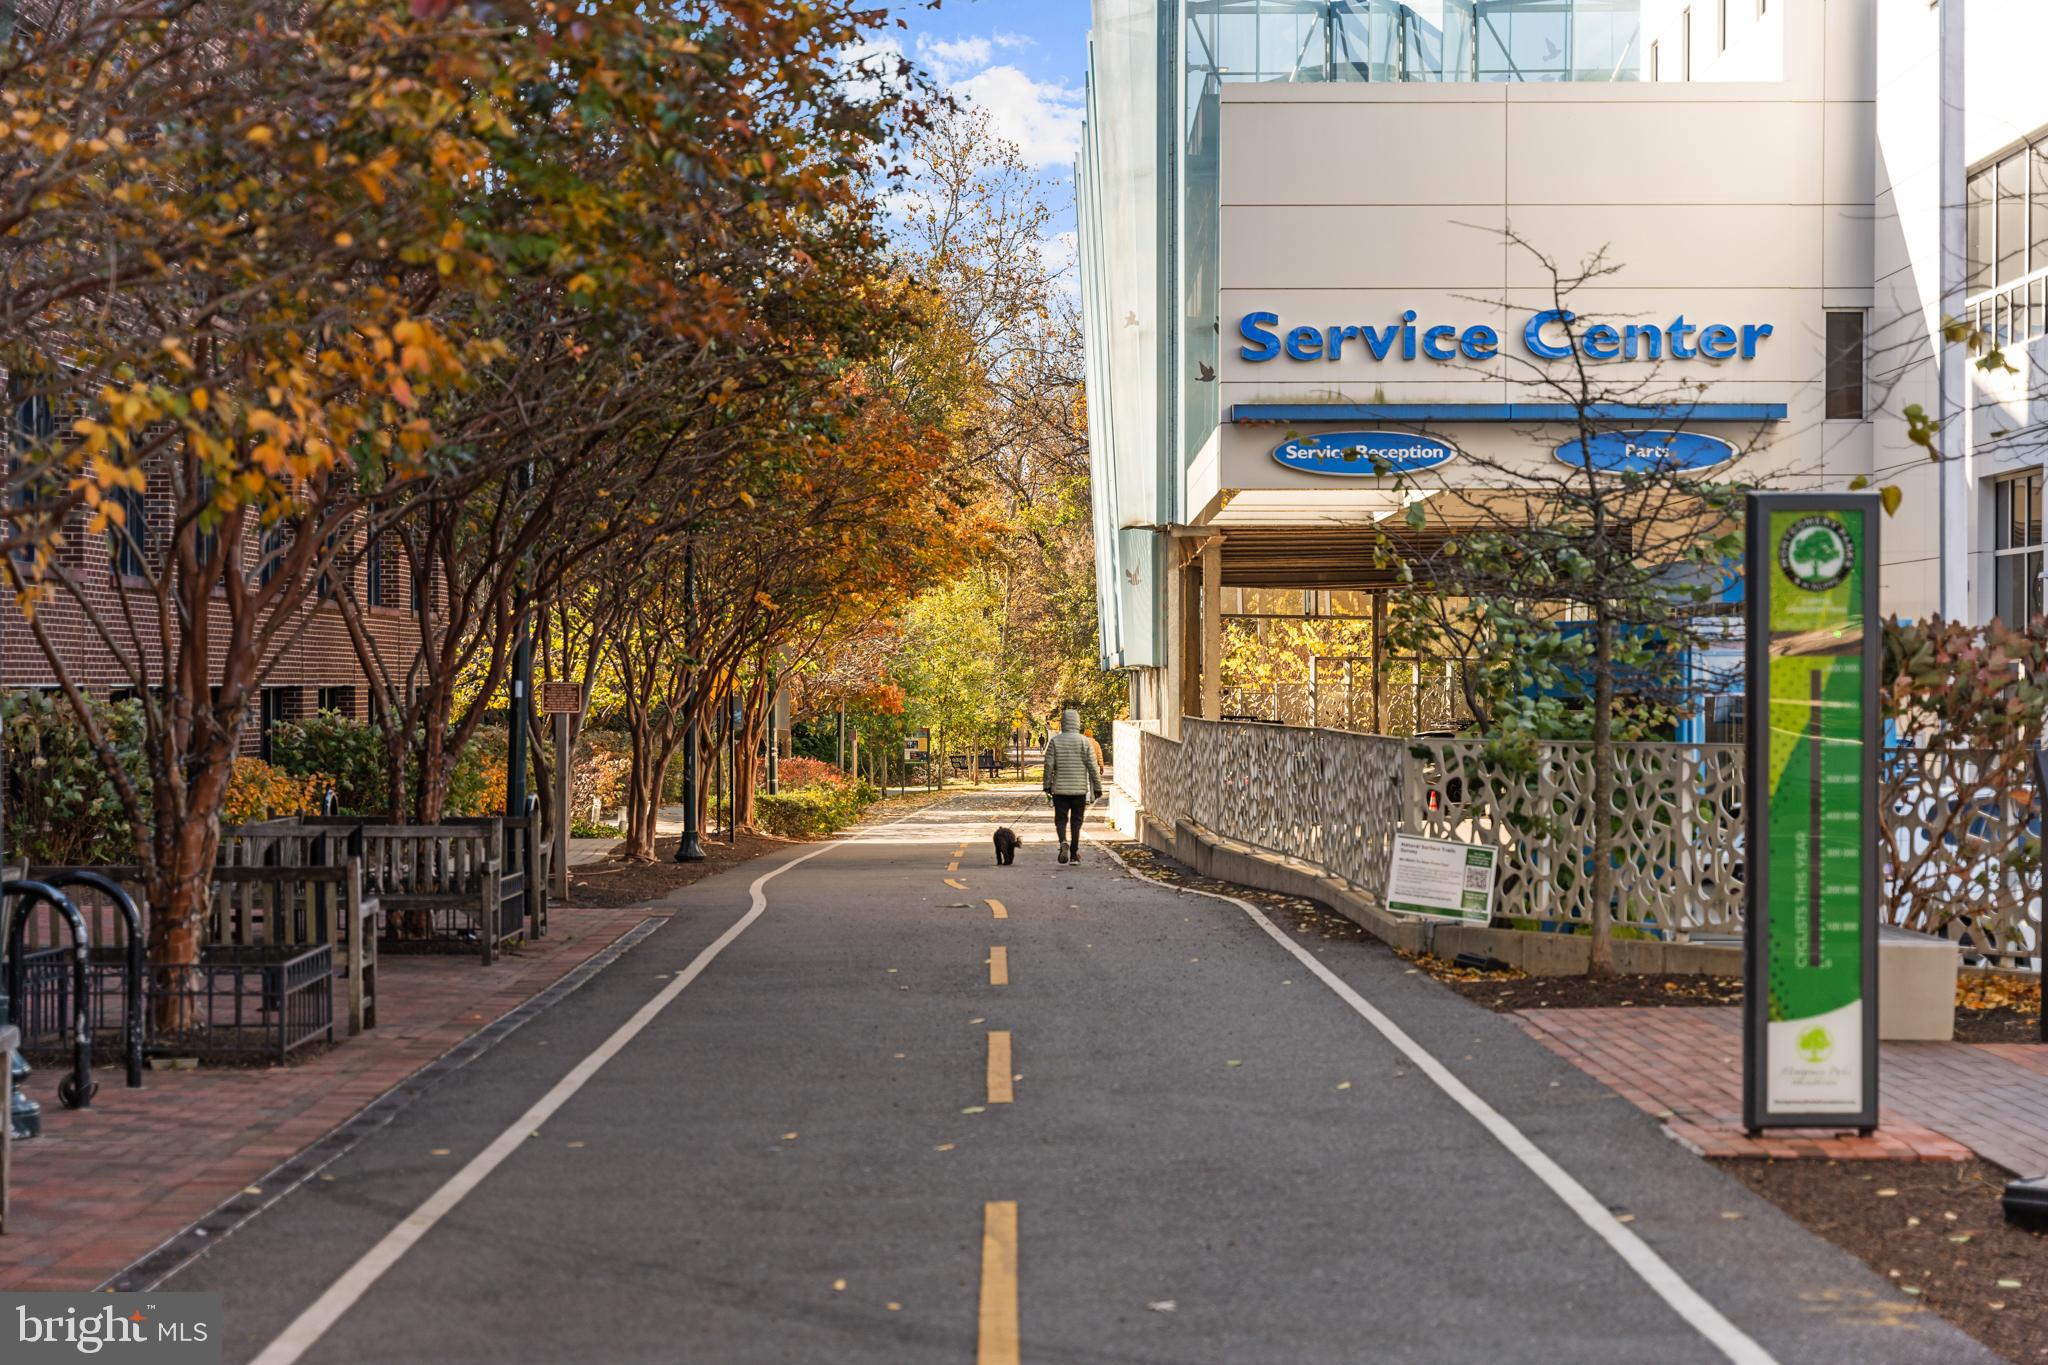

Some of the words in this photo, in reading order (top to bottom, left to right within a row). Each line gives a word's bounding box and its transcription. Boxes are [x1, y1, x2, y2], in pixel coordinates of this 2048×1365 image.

[1239, 309, 1499, 363] Service
[1524, 309, 1774, 363] Center
[1355, 445, 1444, 462] Reception
[1794, 831, 1808, 869] YEAR
[1794, 871, 1808, 902] THIS
[1794, 905, 1808, 968] CYCLISTS
